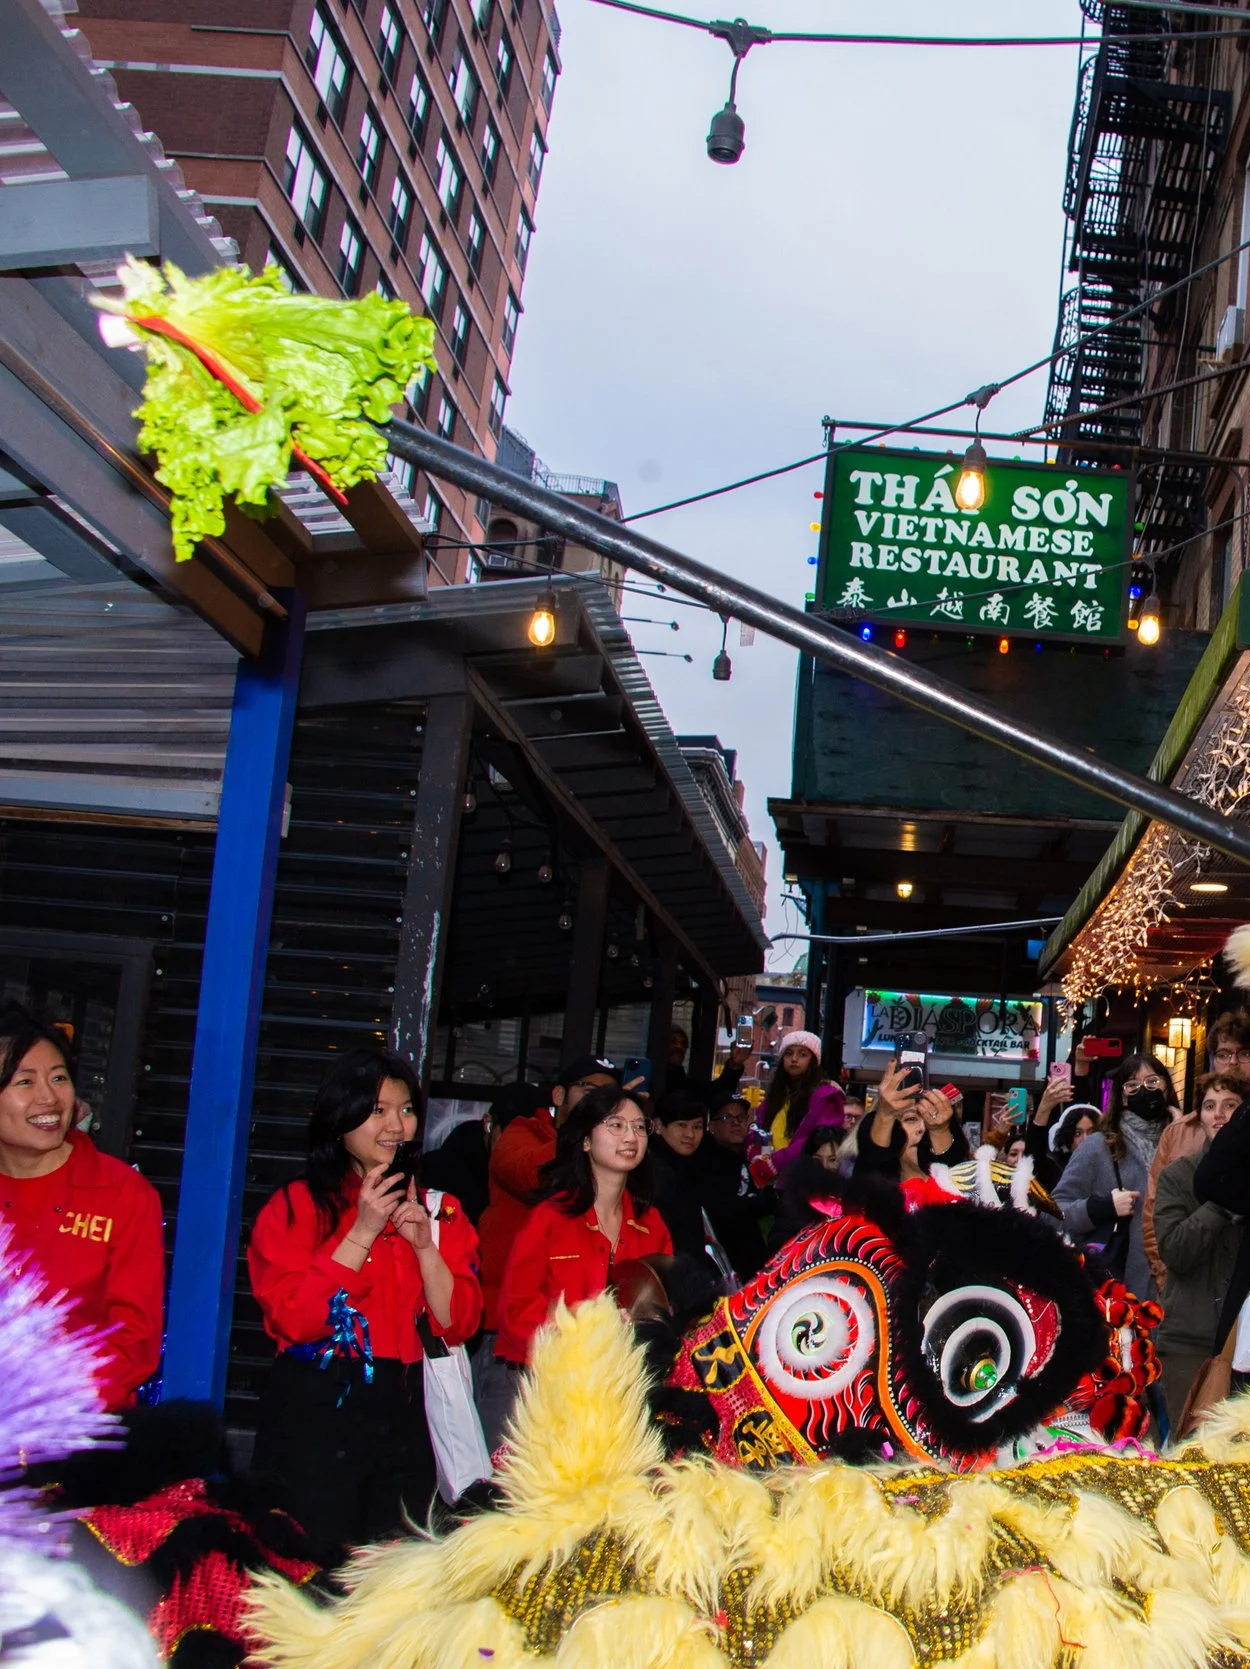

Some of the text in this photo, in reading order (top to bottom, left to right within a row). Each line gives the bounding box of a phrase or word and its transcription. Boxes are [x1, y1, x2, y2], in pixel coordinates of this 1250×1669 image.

[849, 463, 981, 515] THÁ
[853, 510, 1094, 557] VIETNAMESE
[849, 541, 1102, 590] RESTAURANT
[1009, 1039, 1030, 1050] BAR
